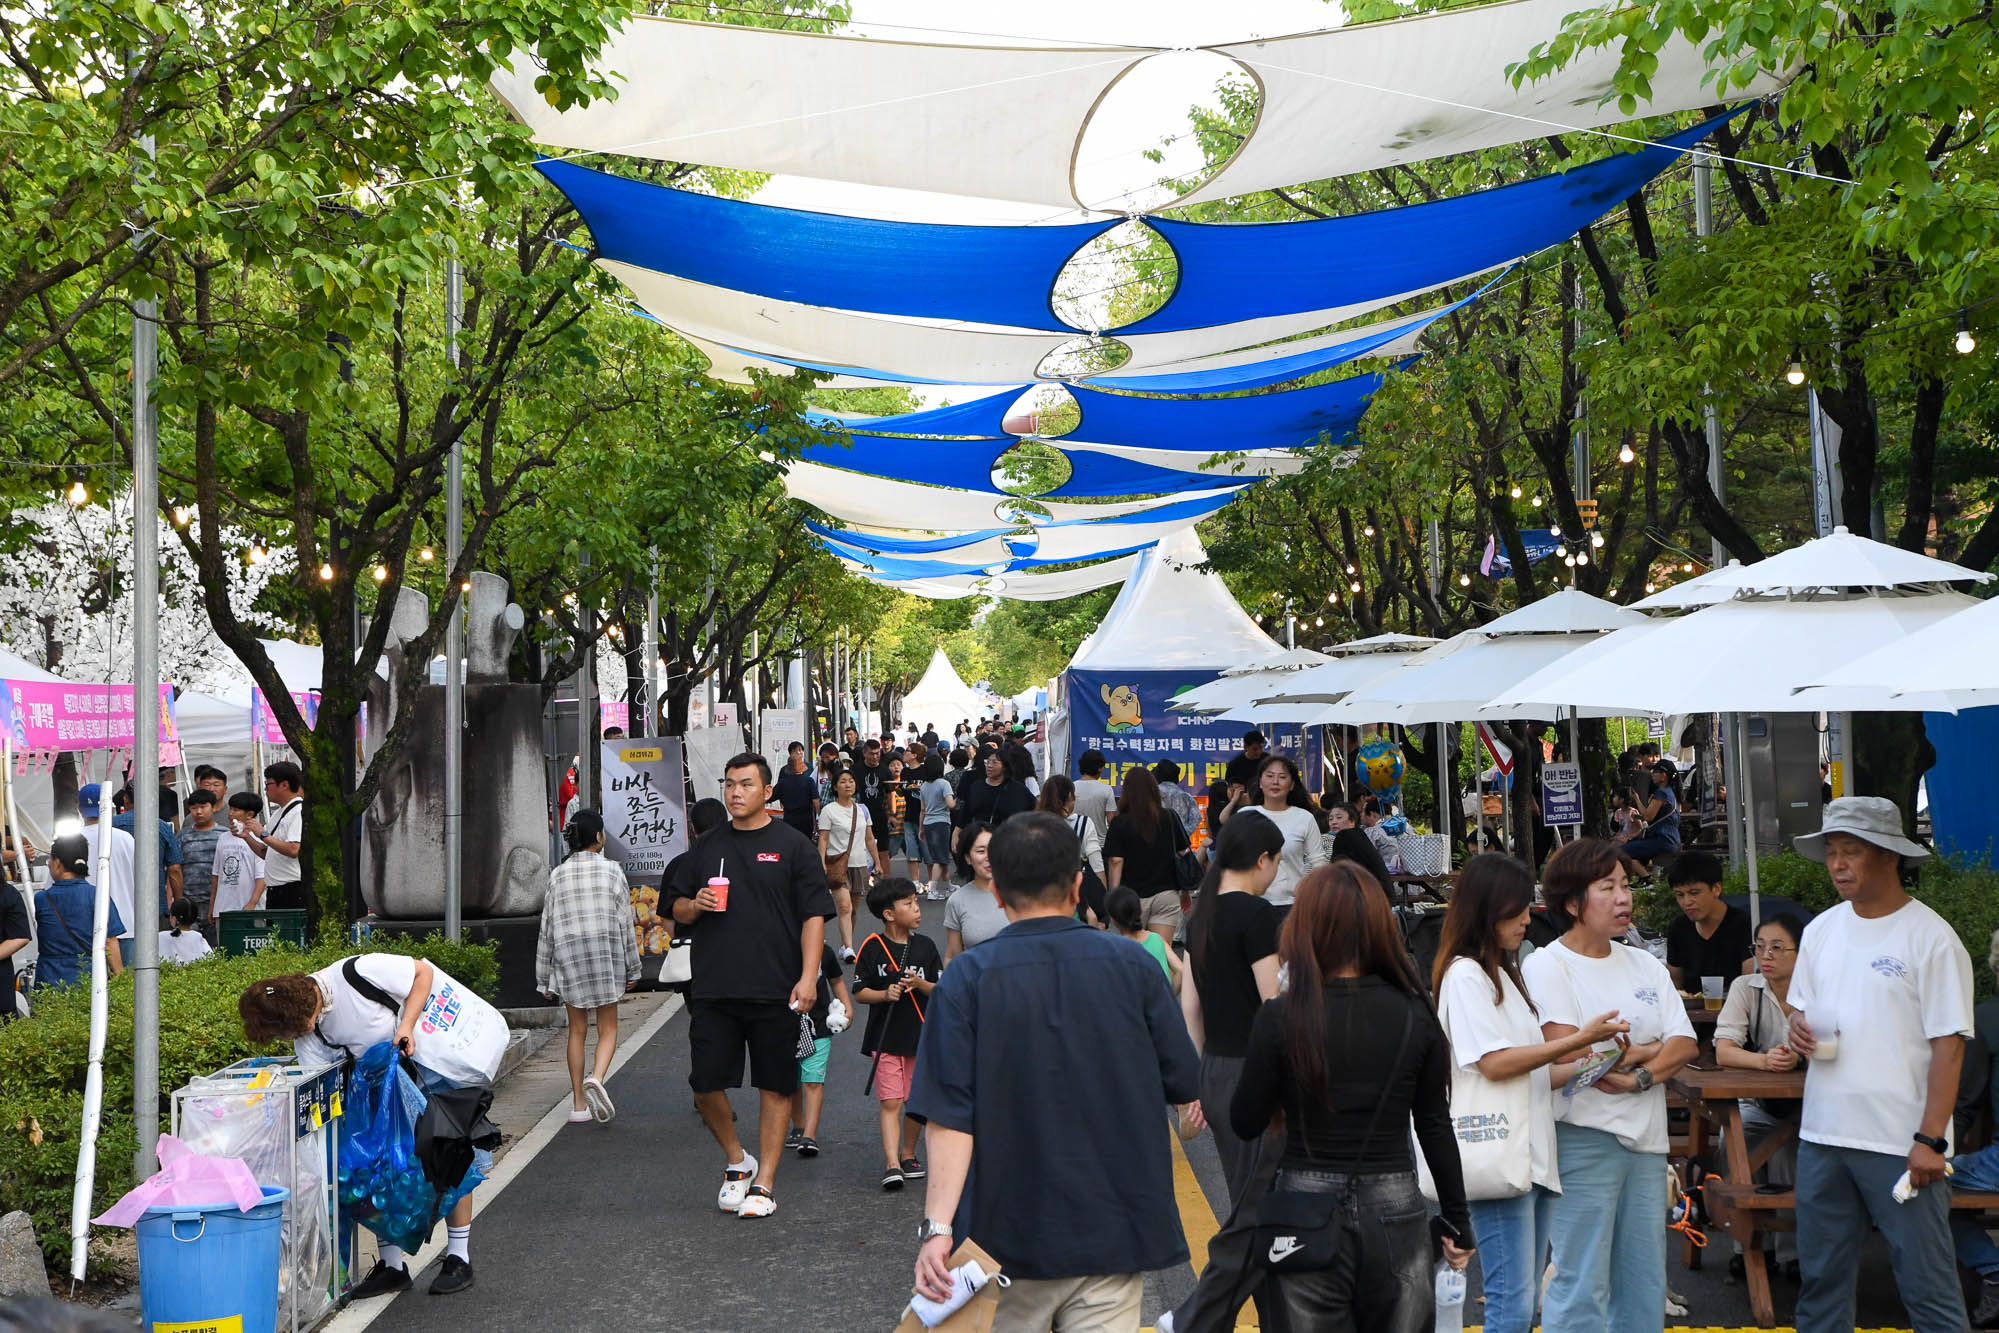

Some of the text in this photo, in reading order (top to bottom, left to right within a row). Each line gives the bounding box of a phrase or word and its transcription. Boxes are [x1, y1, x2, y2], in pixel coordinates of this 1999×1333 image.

[1081, 736, 1184, 752] "한국수력원자력
[1189, 736, 1245, 752] 화천발전
[612, 771, 653, 796] 바삭
[1099, 762, 1194, 787] 다기
[1559, 769, 1577, 780] 반납
[626, 792, 664, 822] 쫀득
[619, 818, 677, 845] 삼겹살
[438, 997, 461, 1032] STATE
[1273, 1236, 1297, 1251] NIKE
